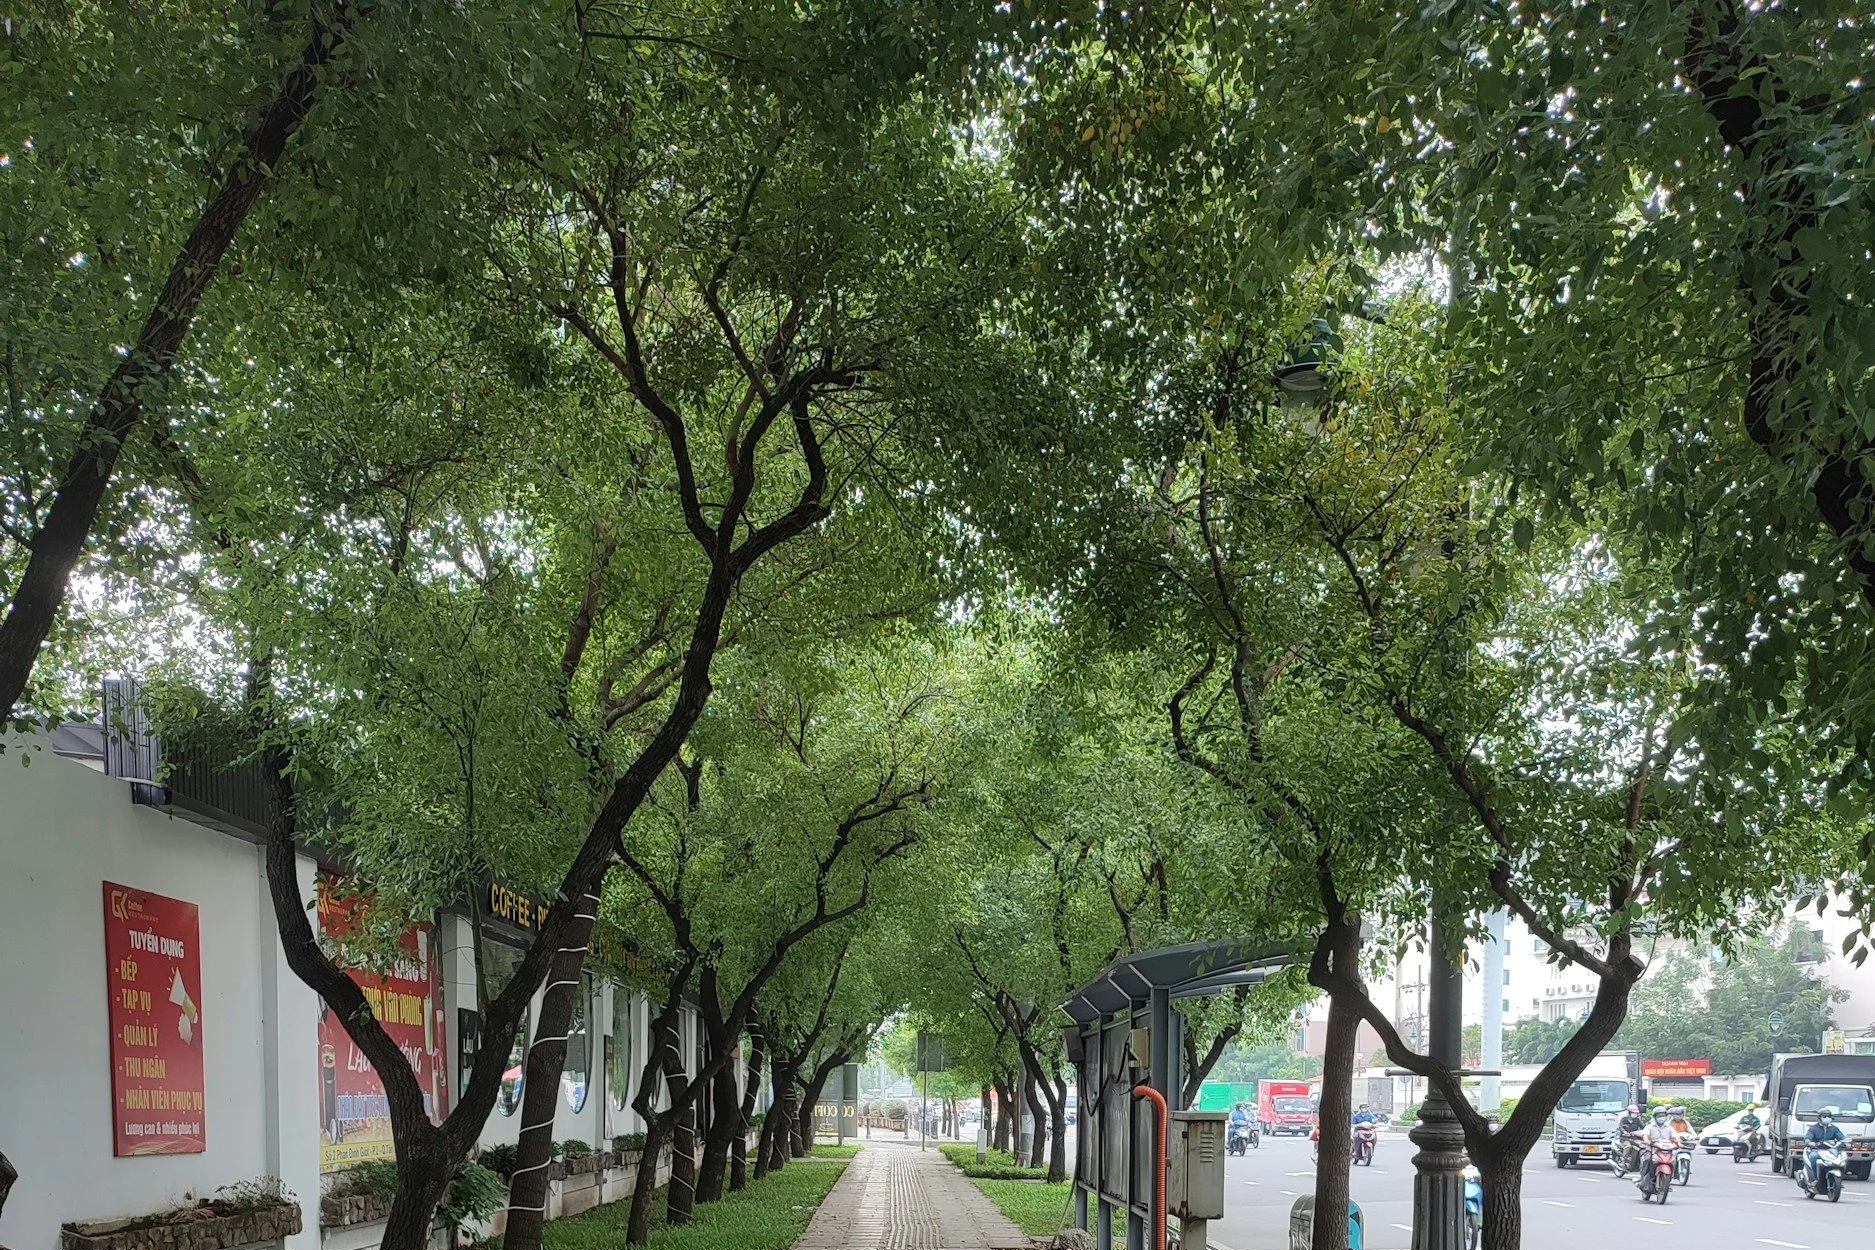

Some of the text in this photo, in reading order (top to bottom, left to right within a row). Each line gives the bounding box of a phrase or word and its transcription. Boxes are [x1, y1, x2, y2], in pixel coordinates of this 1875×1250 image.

[491, 882, 532, 929] COFFEE
[129, 926, 185, 961] TUYỂN DỤNG
[121, 954, 138, 982] BẾP
[122, 988, 151, 1016] TẠP VỤ
[124, 1019, 159, 1048] QUẢN LÝ
[124, 1055, 166, 1079] THU NGÂN
[126, 1085, 203, 1115] NHÂN VIÊN PHỤC VỤ
[144, 1123, 156, 1135] cao
[156, 1121, 161, 1135] &
